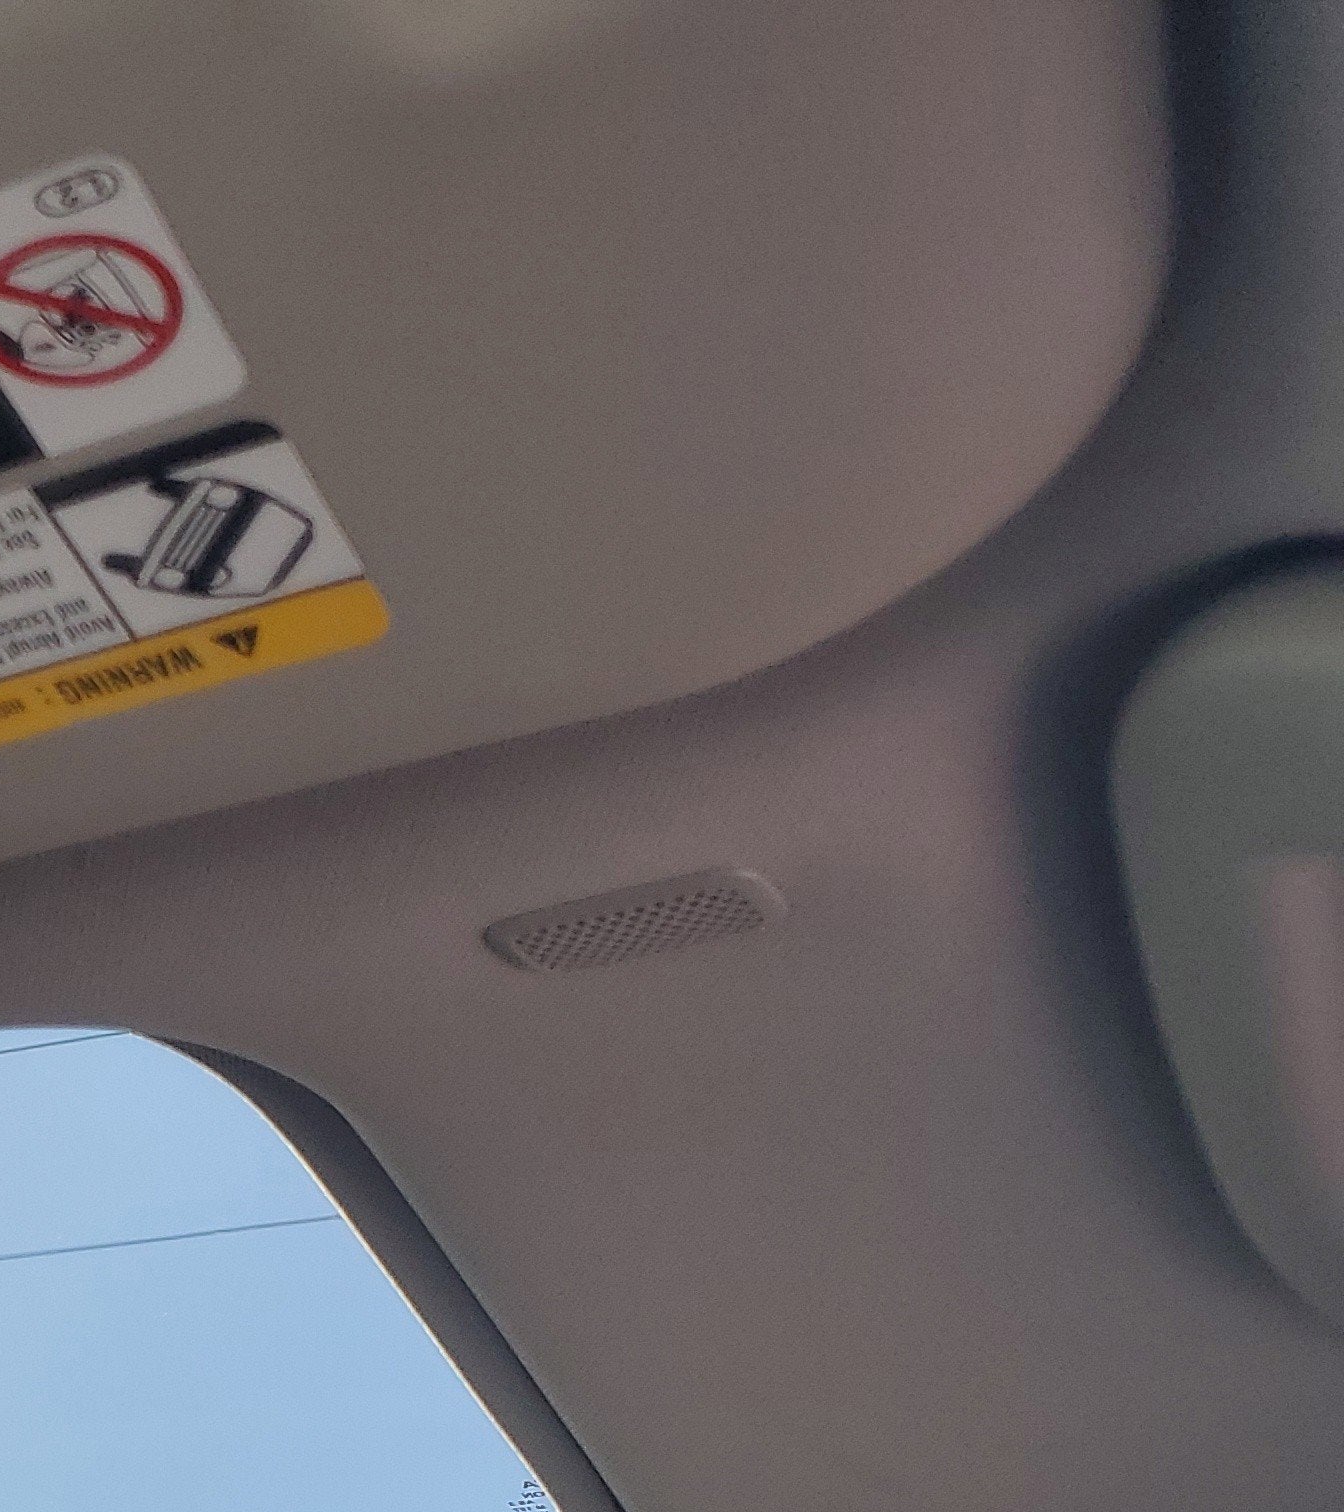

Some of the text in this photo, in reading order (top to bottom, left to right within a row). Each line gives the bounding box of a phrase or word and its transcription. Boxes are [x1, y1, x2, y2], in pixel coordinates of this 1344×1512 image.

[3, 502, 43, 529] For
[50, 596, 94, 623] and
[60, 614, 118, 644] Avoid
